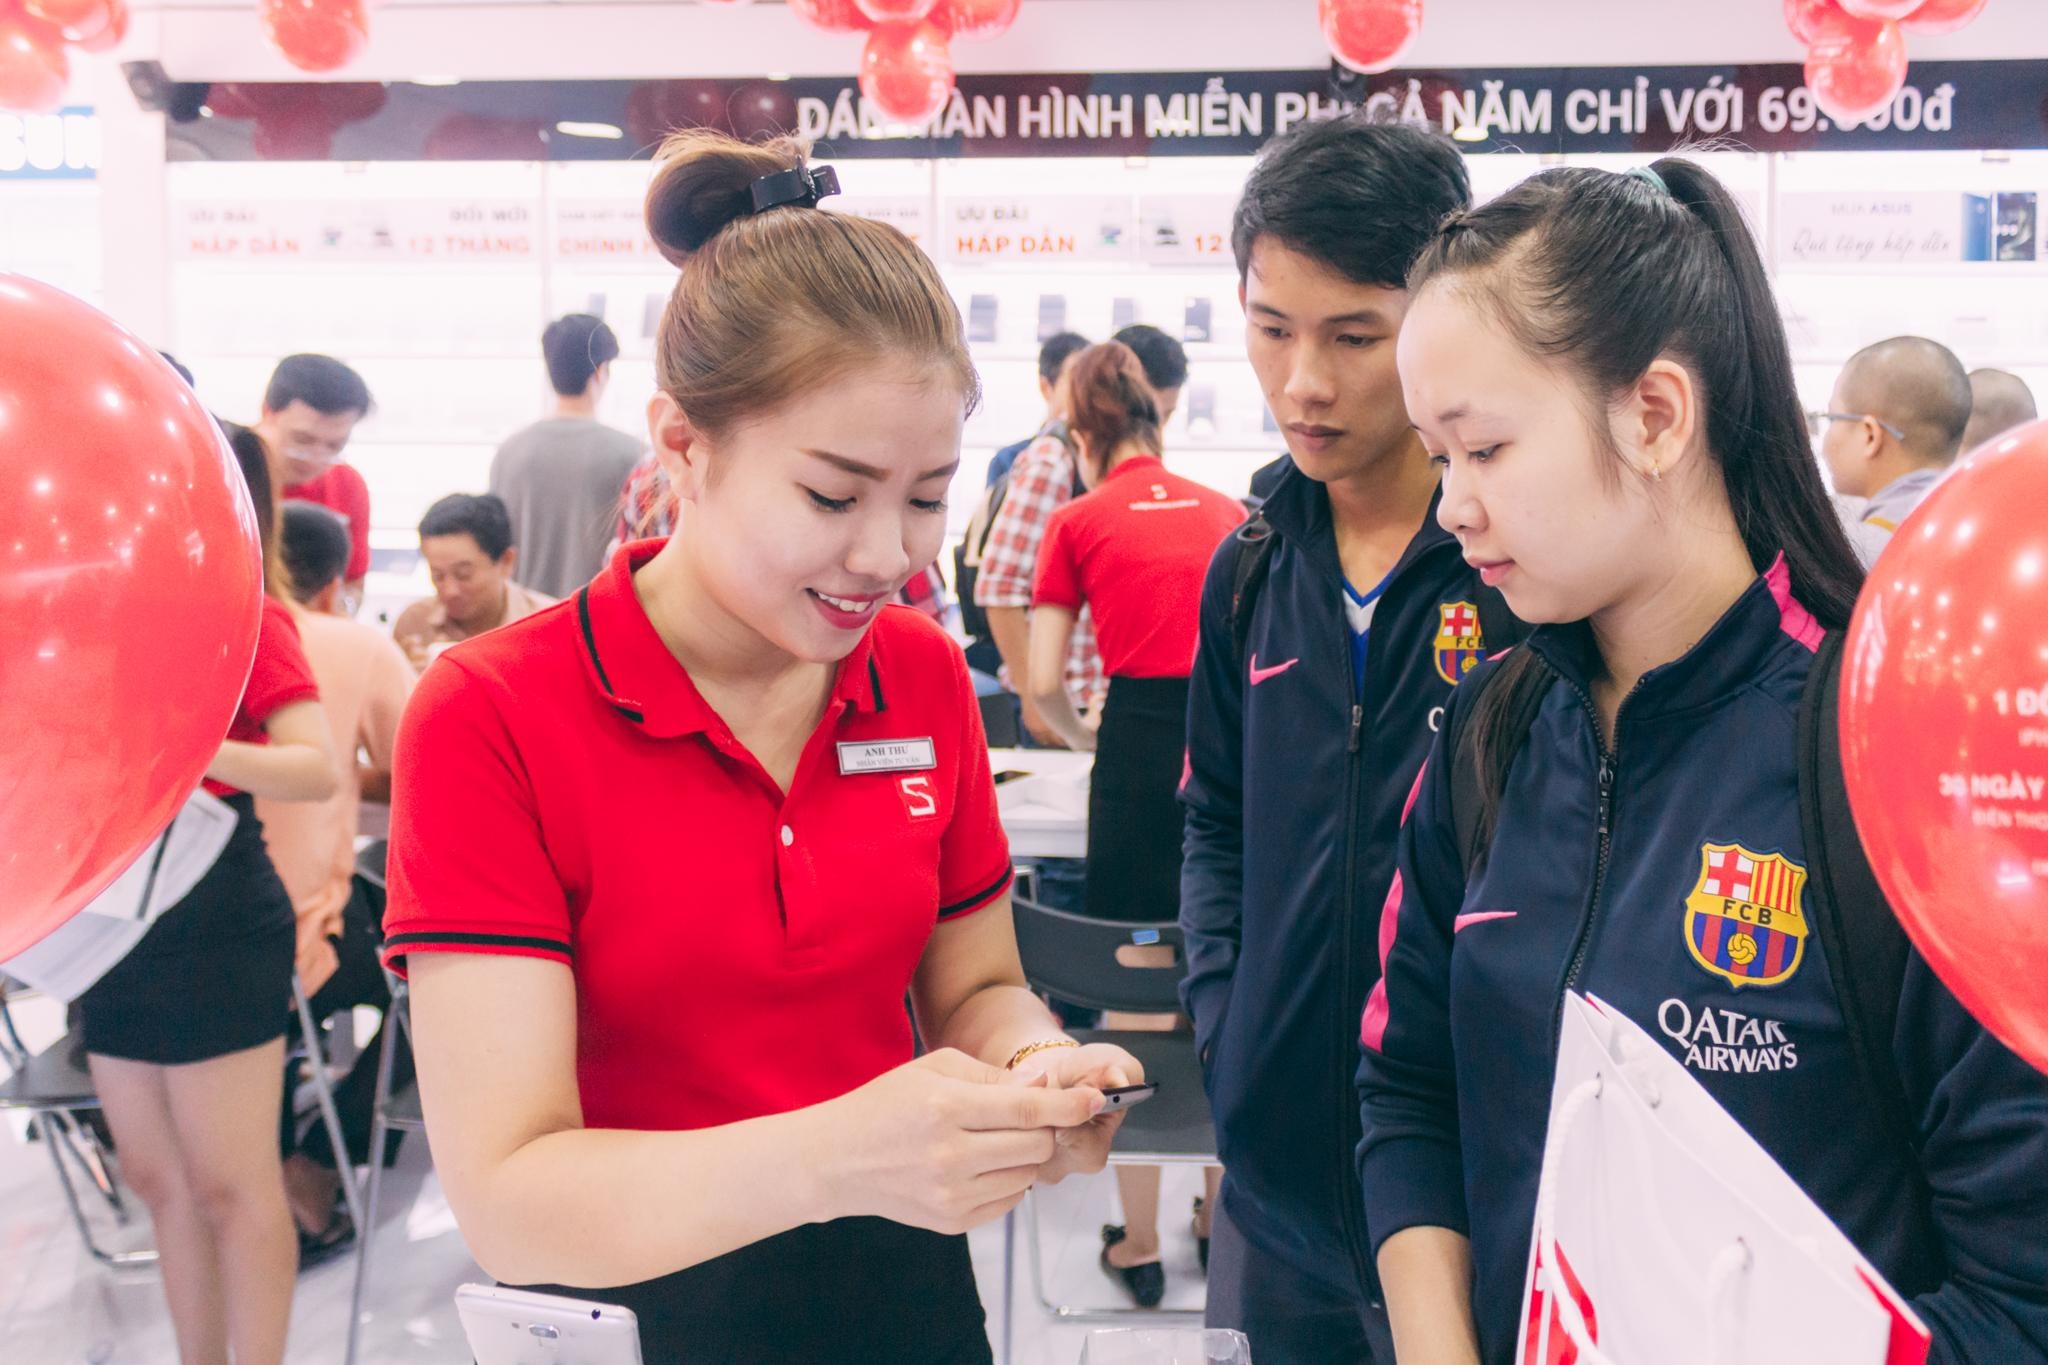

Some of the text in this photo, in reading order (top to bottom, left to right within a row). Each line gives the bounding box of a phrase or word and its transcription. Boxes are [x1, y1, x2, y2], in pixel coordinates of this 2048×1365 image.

[1018, 86, 1133, 138] HÌNH
[1145, 76, 1262, 137] MIỄN
[1441, 79, 1552, 134] NĂM
[1564, 76, 1649, 133] CHỈ
[1659, 75, 1743, 133] VỚI
[864, 747, 886, 757] ANH
[1970, 769, 2045, 801] NGÀY
[1722, 899, 1773, 926] FCB
[1684, 1043, 1799, 1073] AIRWAYS
